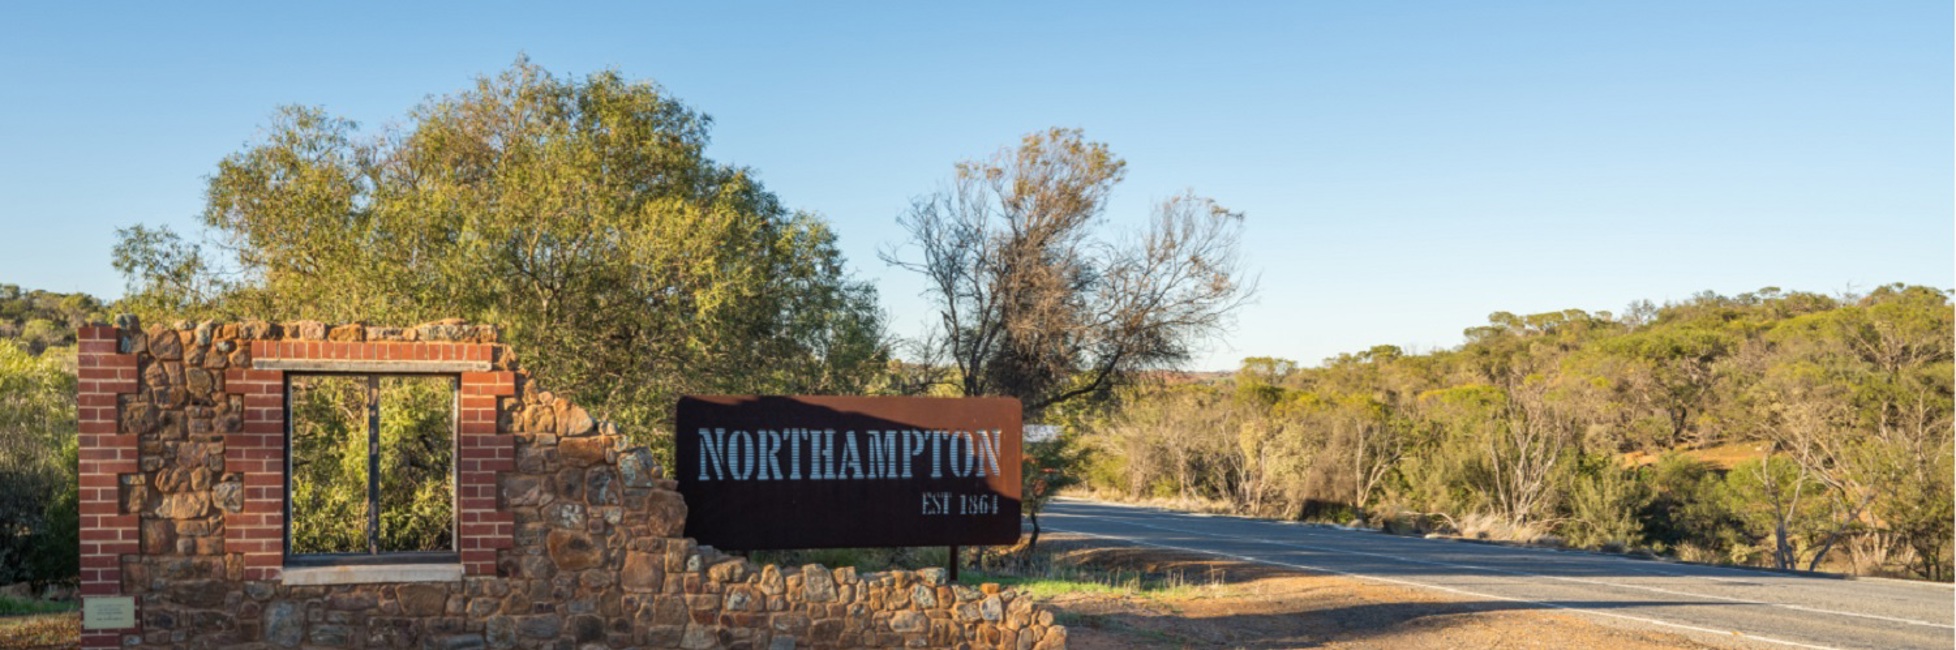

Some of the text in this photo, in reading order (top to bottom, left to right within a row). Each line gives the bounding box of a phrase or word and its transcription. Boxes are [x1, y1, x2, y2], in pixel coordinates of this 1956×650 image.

[698, 427, 1003, 481] NORTHAMPTON
[922, 492, 999, 515] EST 1864
